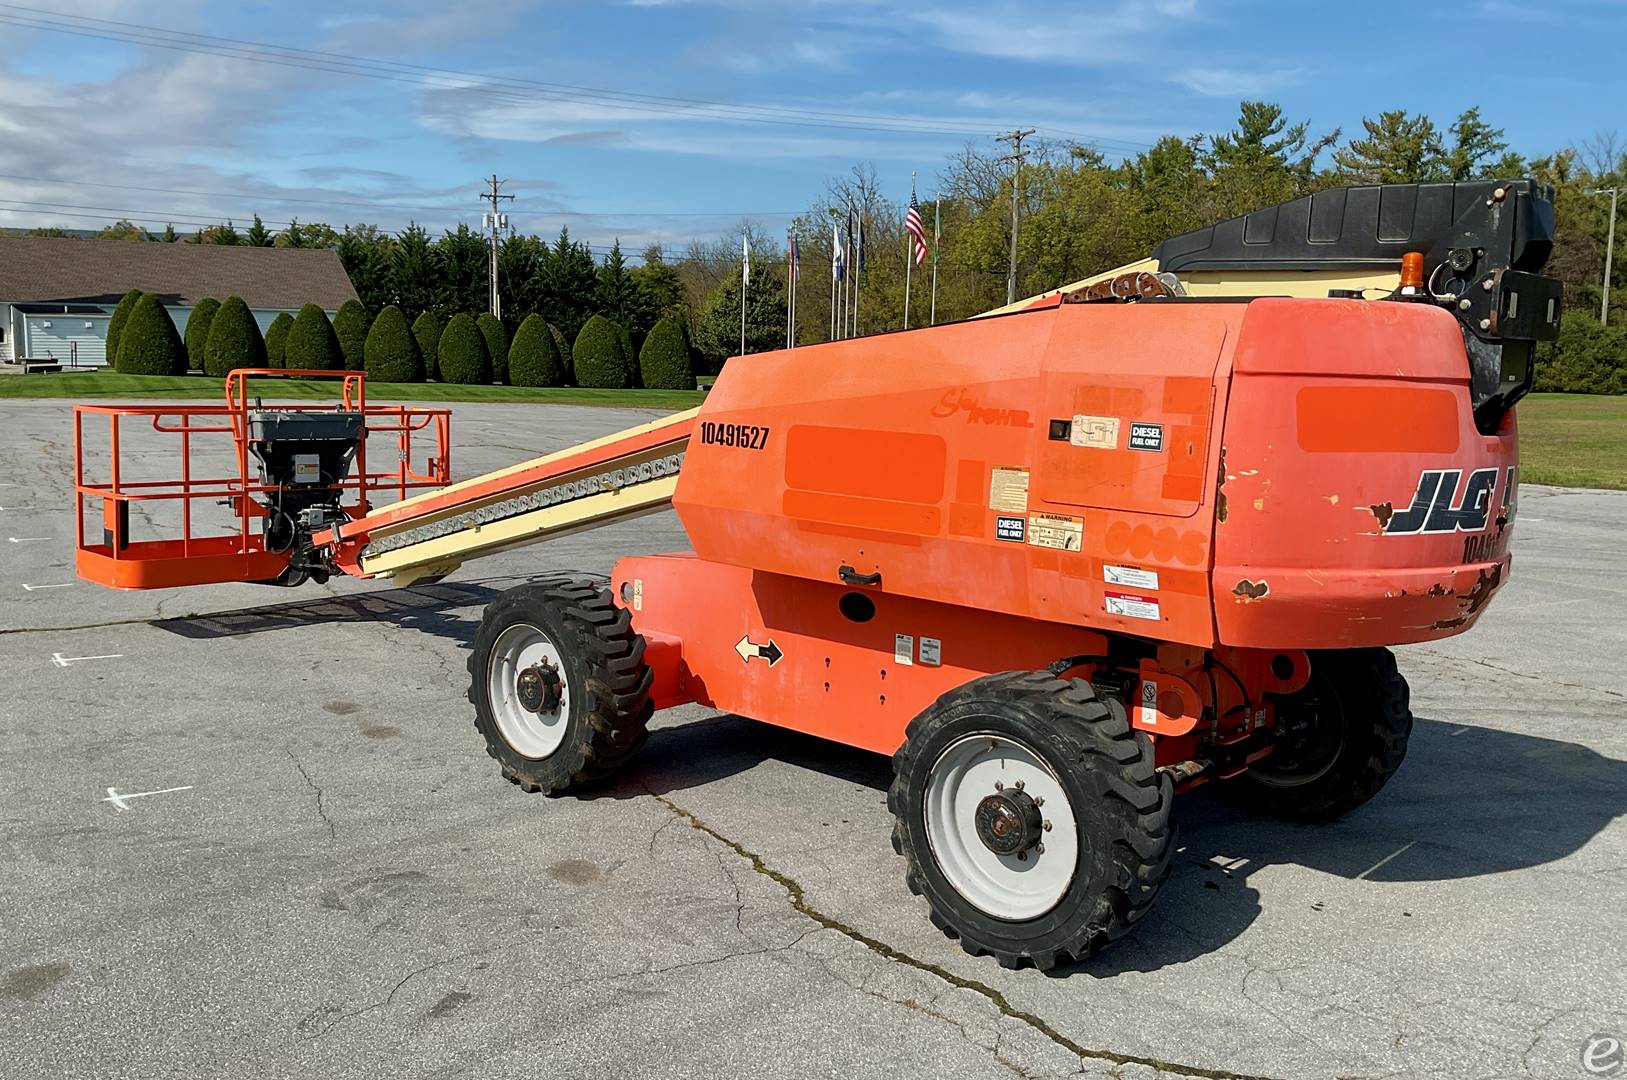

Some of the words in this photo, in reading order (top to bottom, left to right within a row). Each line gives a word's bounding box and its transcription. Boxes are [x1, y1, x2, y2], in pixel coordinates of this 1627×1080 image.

[701, 421, 769, 450] 10491527
[1132, 427, 1161, 438] DIESEL
[1131, 437, 1145, 445] FUEL
[1145, 438, 1161, 447] ONLY
[1384, 467, 1499, 535] JLG
[1045, 514, 1073, 523] WARNING
[998, 519, 1024, 530] DIESEL
[998, 528, 1010, 536] FUEL
[1009, 530, 1023, 538] ONLY
